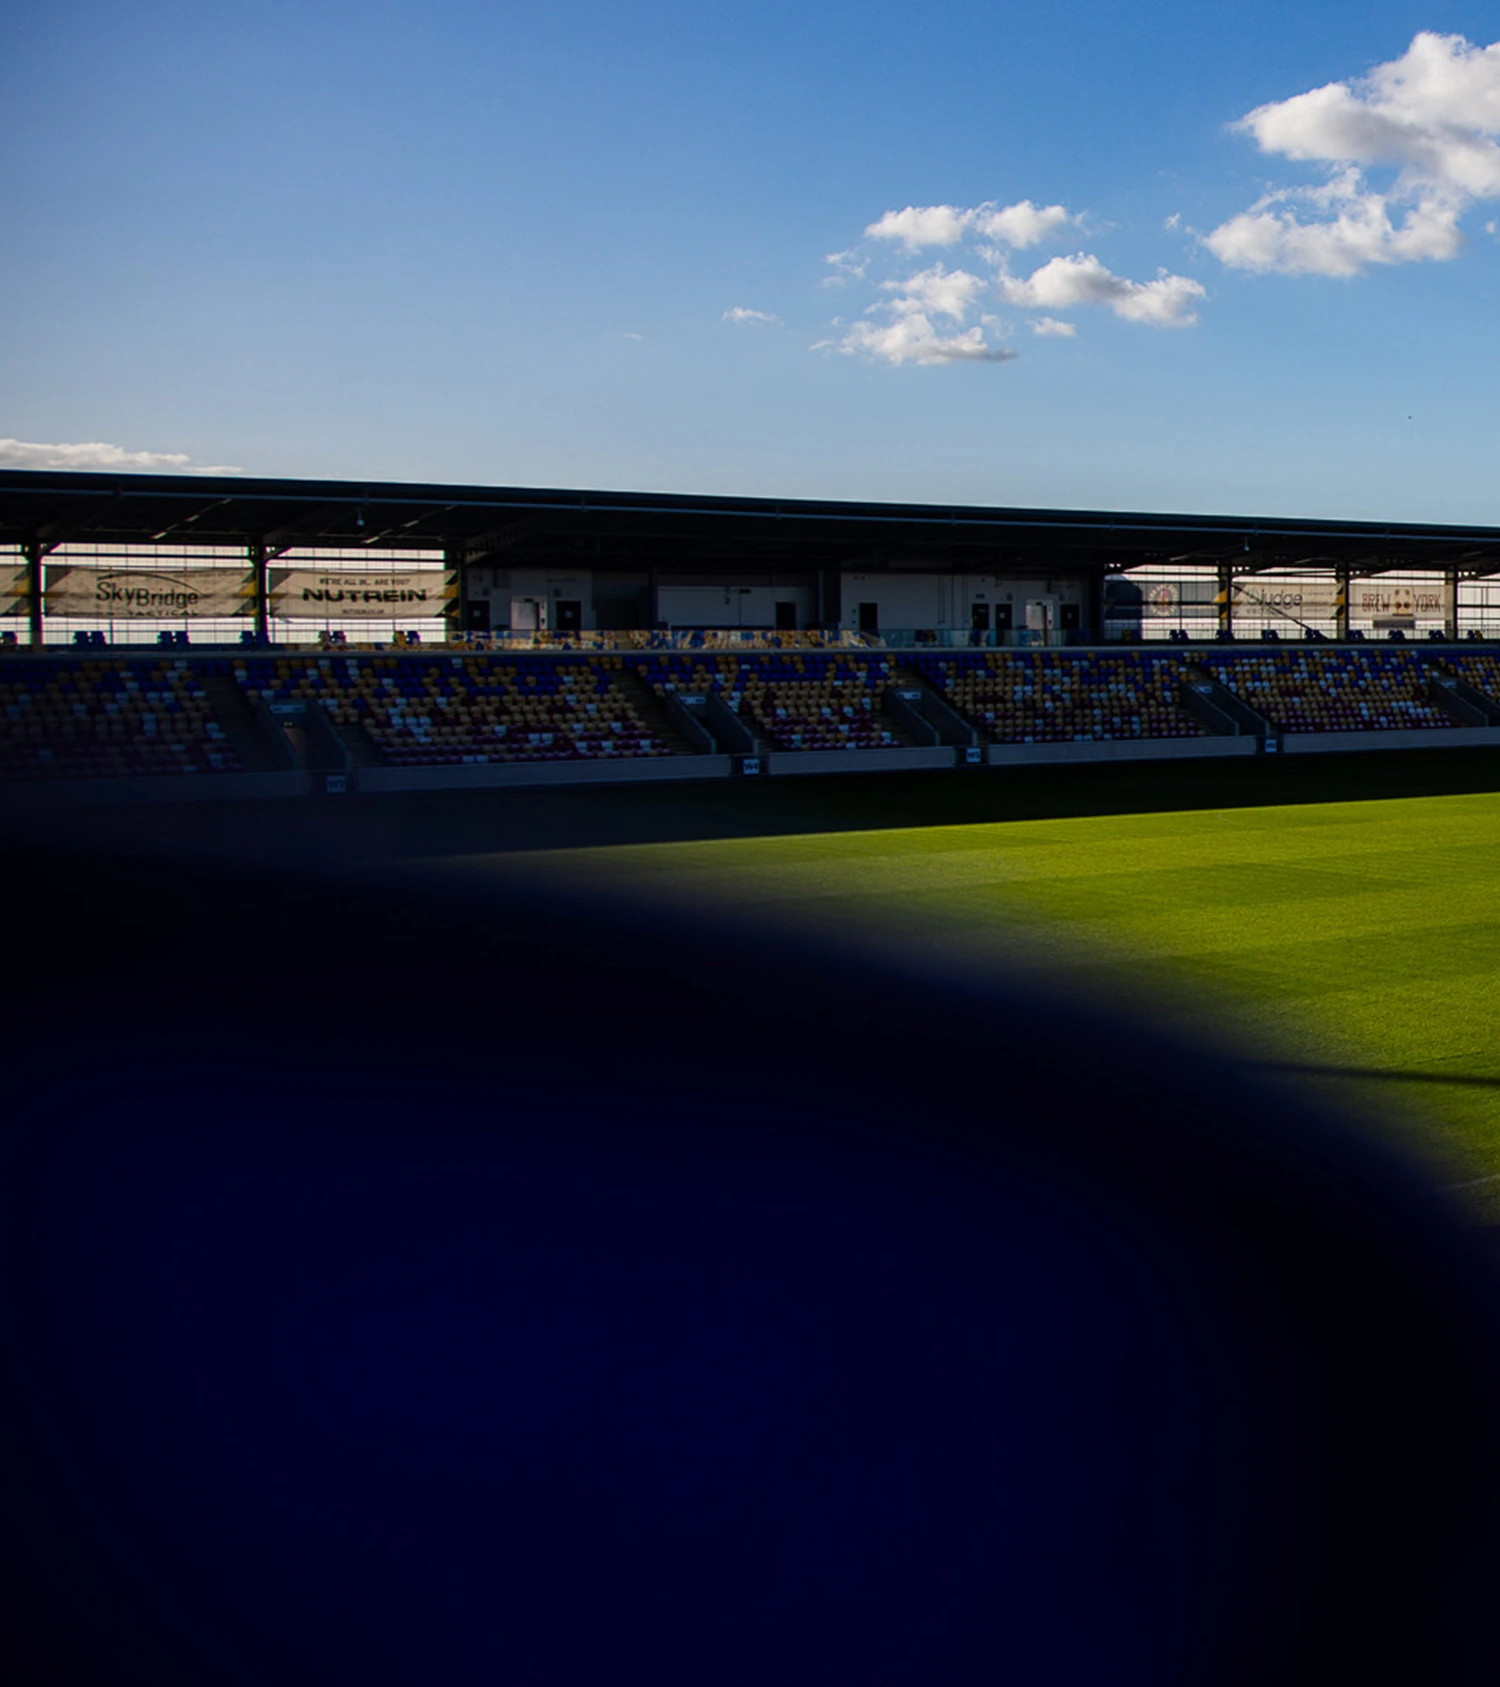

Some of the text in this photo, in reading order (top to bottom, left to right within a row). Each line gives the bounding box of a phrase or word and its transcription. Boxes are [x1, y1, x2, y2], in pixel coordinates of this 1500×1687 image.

[374, 578, 389, 586] ARE
[96, 582, 198, 608] SkyBridge
[302, 588, 427, 603] NUTREIN
[1362, 593, 1441, 612] BREW YORK
